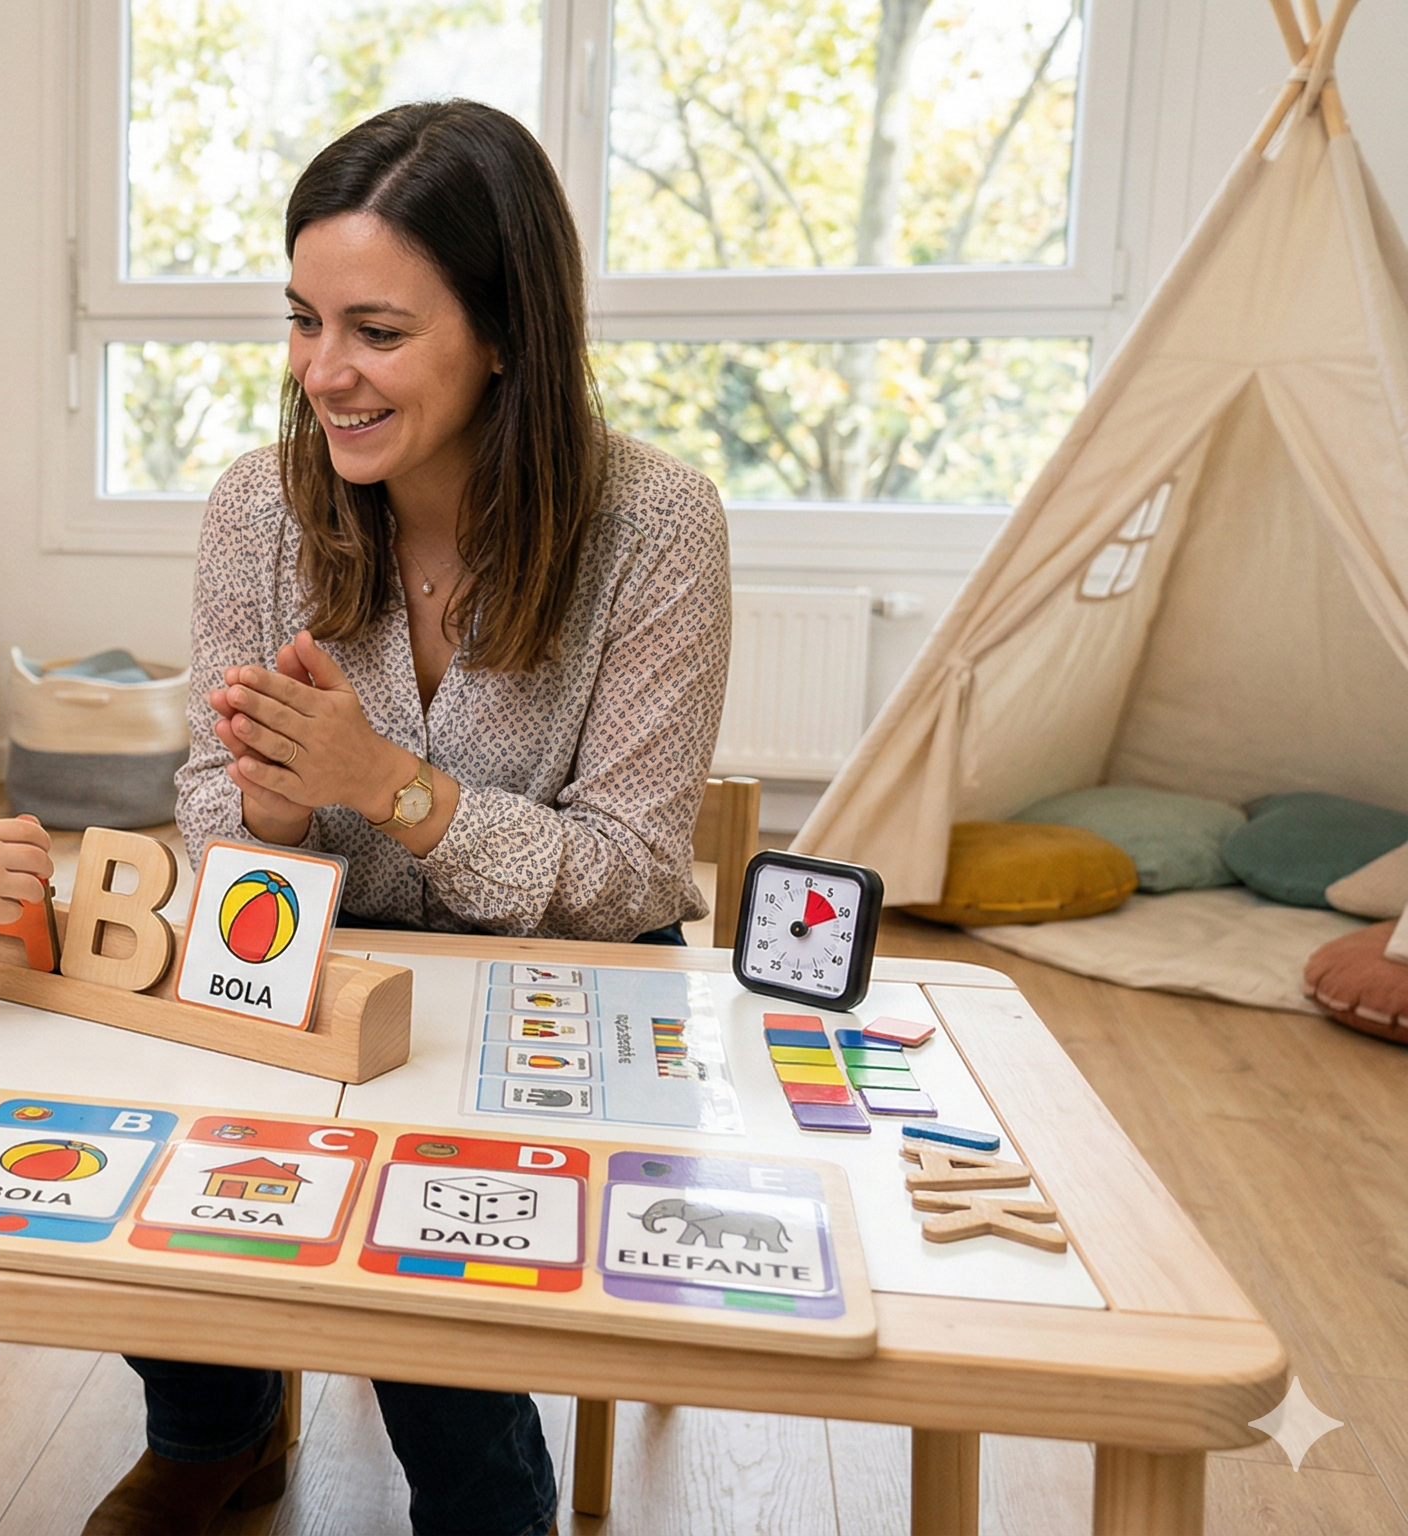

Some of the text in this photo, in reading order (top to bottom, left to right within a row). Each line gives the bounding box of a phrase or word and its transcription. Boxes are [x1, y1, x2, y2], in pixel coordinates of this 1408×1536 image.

[783, 879, 791, 891] 5
[826, 887, 835, 898] 5
[60, 826, 178, 993] B
[764, 893, 851, 919] 10 50
[757, 916, 768, 927] 15
[757, 939, 769, 950] 20
[840, 932, 852, 943] 45
[770, 959, 782, 971] 25
[831, 955, 843, 966] 40
[791, 970, 803, 981] 30
[812, 969, 824, 980] 35
[208, 973, 274, 1010] BOLA
[109, 1110, 154, 1133] B
[308, 1128, 355, 1151] C
[517, 1145, 567, 1169] D
[749, 1166, 788, 1191] E
[190, 1204, 284, 1226] CASA
[420, 1228, 531, 1250] DADO
[618, 1249, 812, 1282] ELEFANTE
